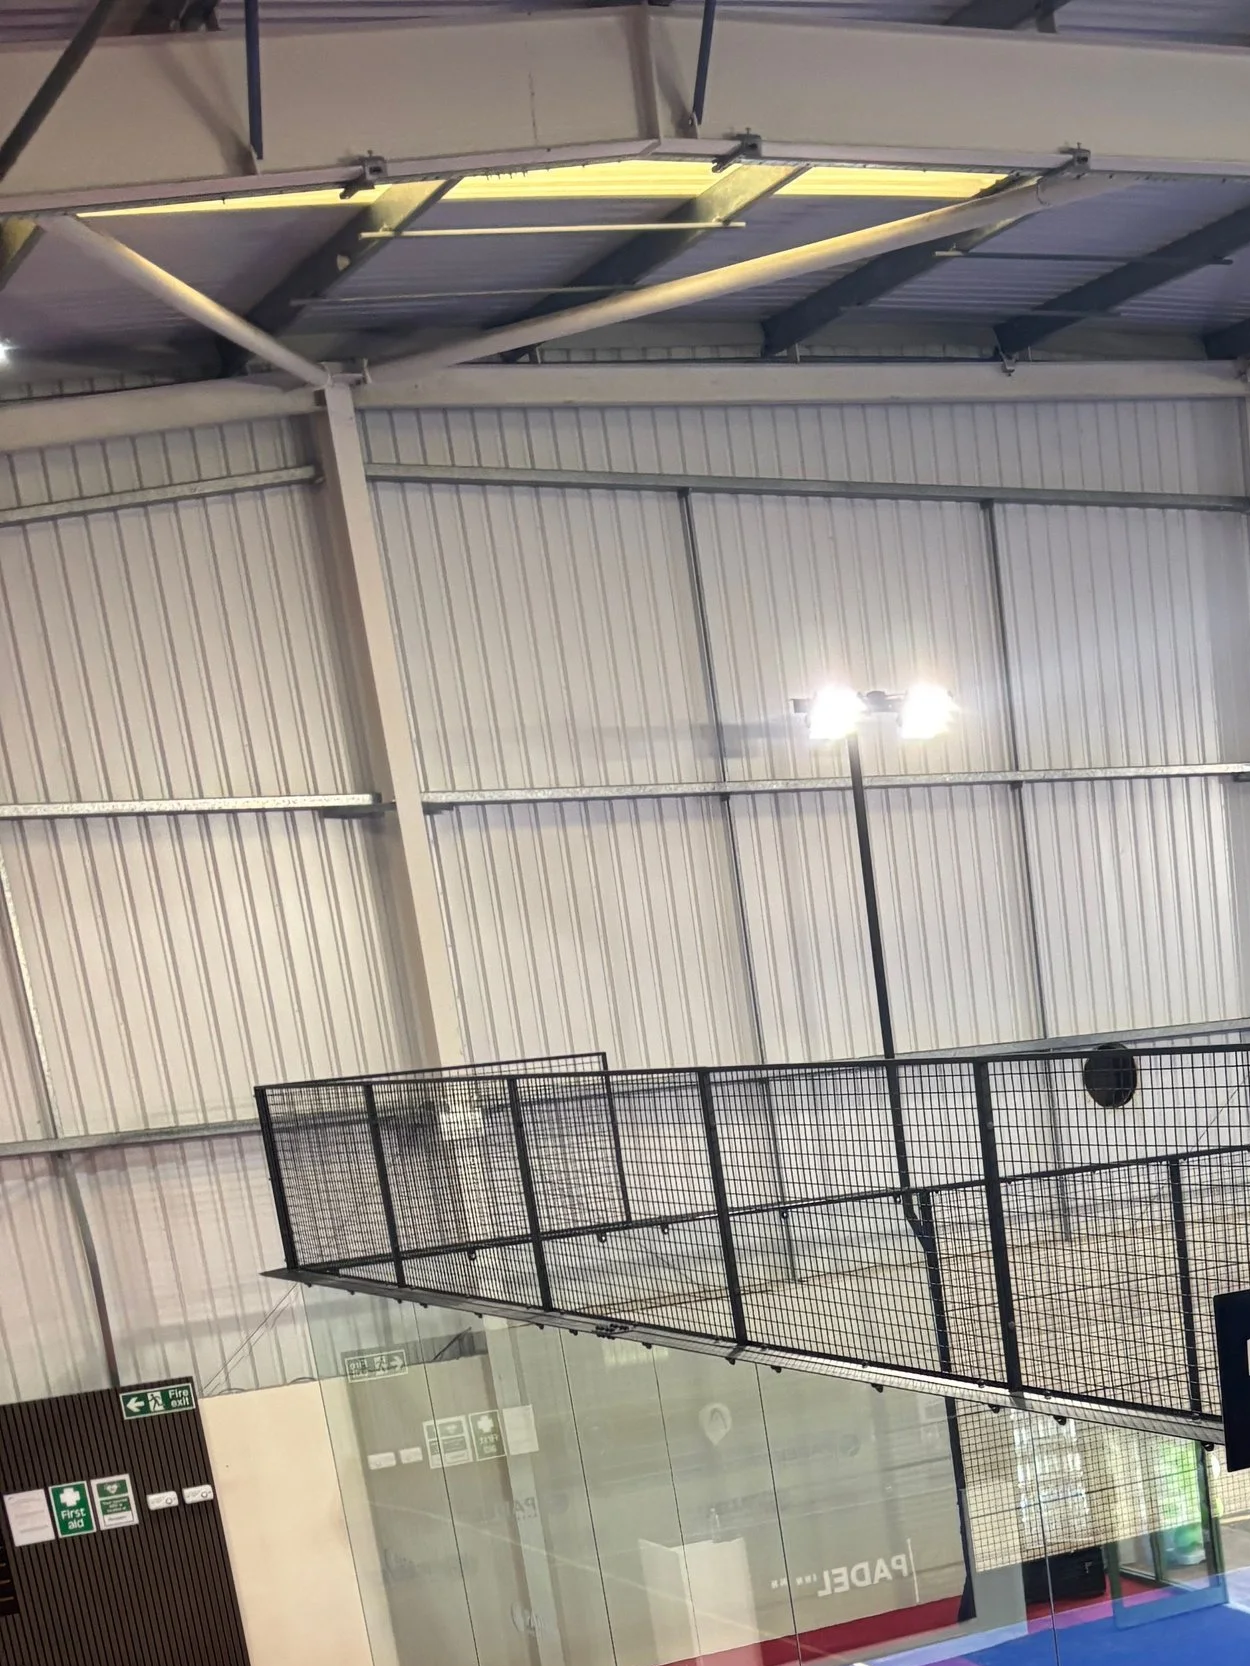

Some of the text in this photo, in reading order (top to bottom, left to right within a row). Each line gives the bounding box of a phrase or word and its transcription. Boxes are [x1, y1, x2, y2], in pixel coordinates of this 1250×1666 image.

[168, 1389, 189, 1399] Fire
[171, 1396, 189, 1408] exit
[61, 1508, 86, 1520] First
[68, 1518, 85, 1530] aid
